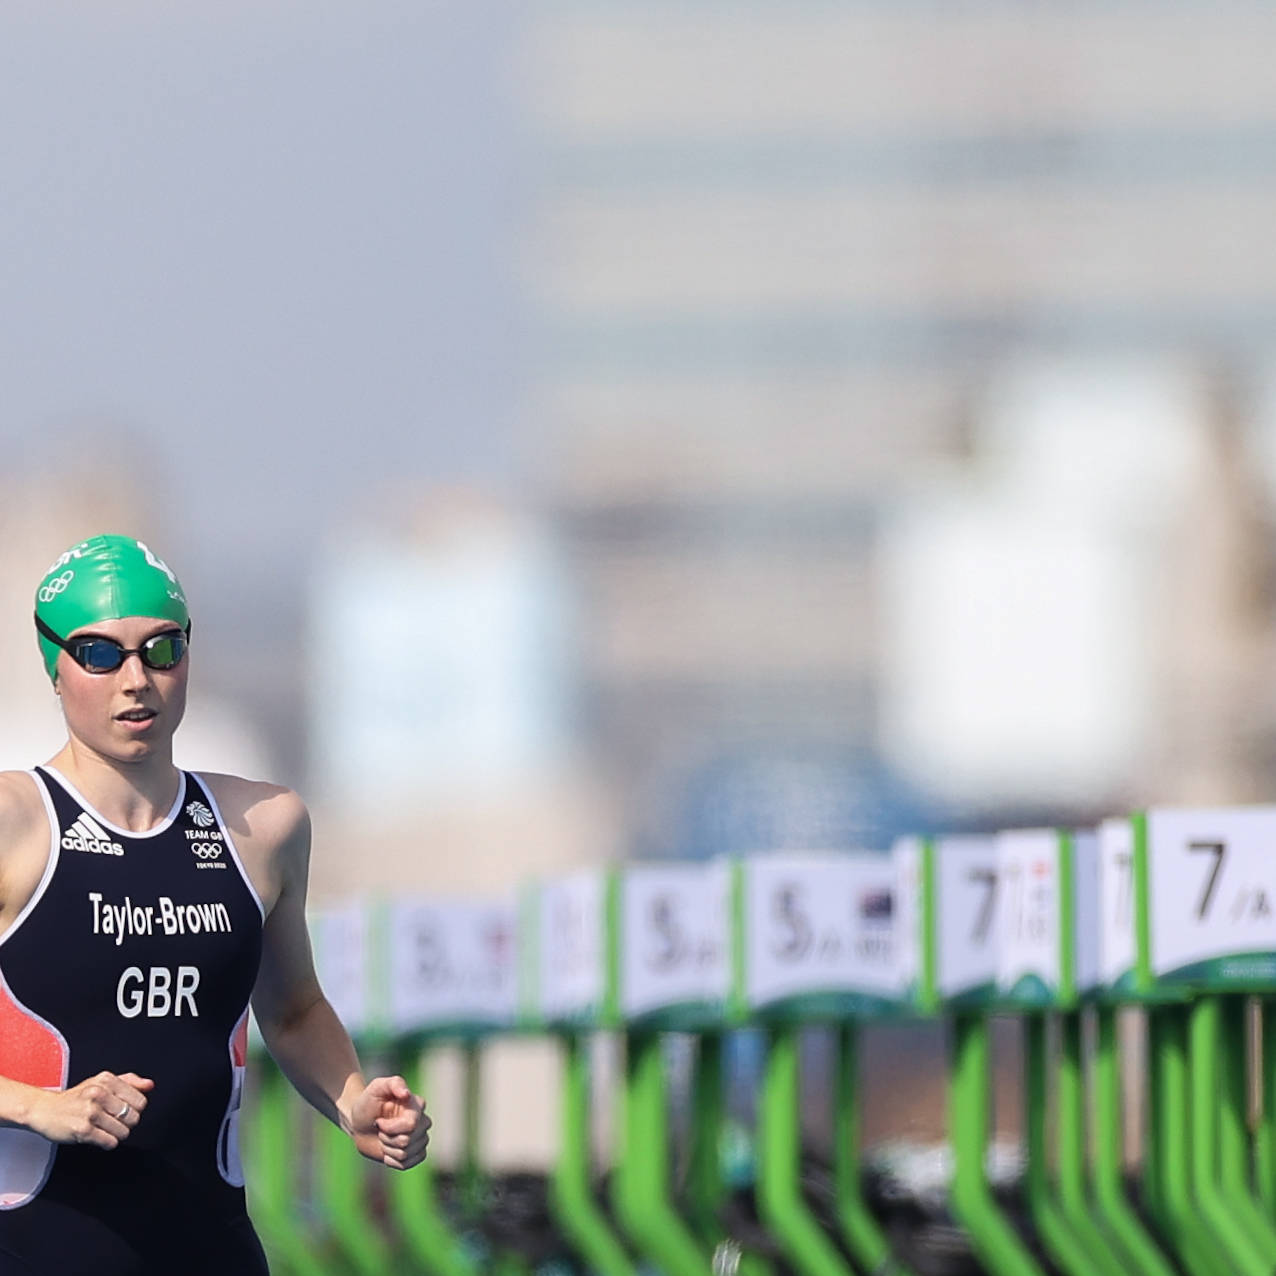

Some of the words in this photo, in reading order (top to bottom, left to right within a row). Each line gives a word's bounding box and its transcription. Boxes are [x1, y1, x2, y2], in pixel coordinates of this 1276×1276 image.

[61, 836, 124, 856] adidas
[185, 830, 209, 840] TEAM
[89, 892, 232, 946] Taylor-Brown
[116, 966, 200, 1018] GBR
